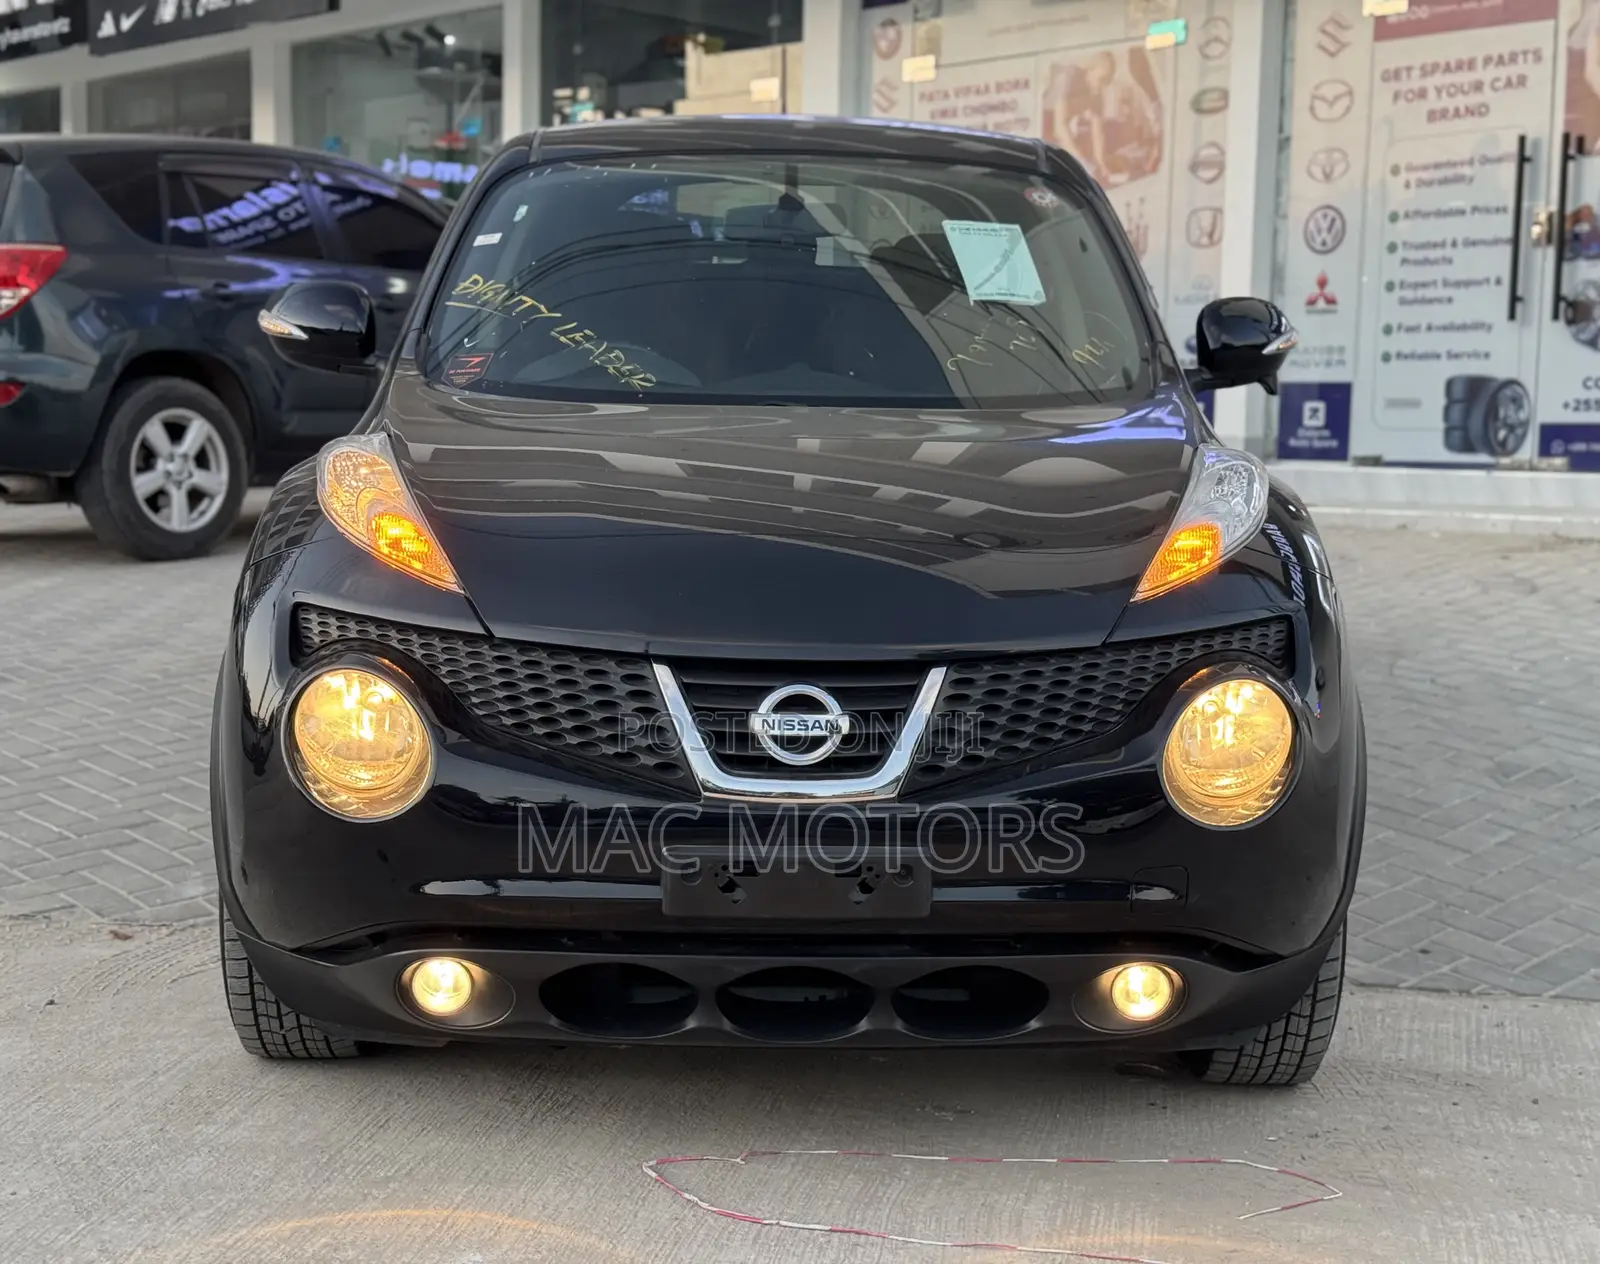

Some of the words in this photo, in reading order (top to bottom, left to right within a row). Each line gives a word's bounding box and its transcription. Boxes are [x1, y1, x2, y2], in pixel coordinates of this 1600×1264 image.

[1380, 65, 1414, 83] GET
[1419, 56, 1477, 79] SPARE
[1483, 48, 1543, 70] PARTS
[1393, 86, 1428, 105] FOR
[1434, 79, 1484, 100] YOUR
[1490, 74, 1528, 93] CAR
[1427, 102, 1490, 124] BRAND
[1403, 208, 1467, 220] Affordable
[762, 719, 839, 731] NISSAN
